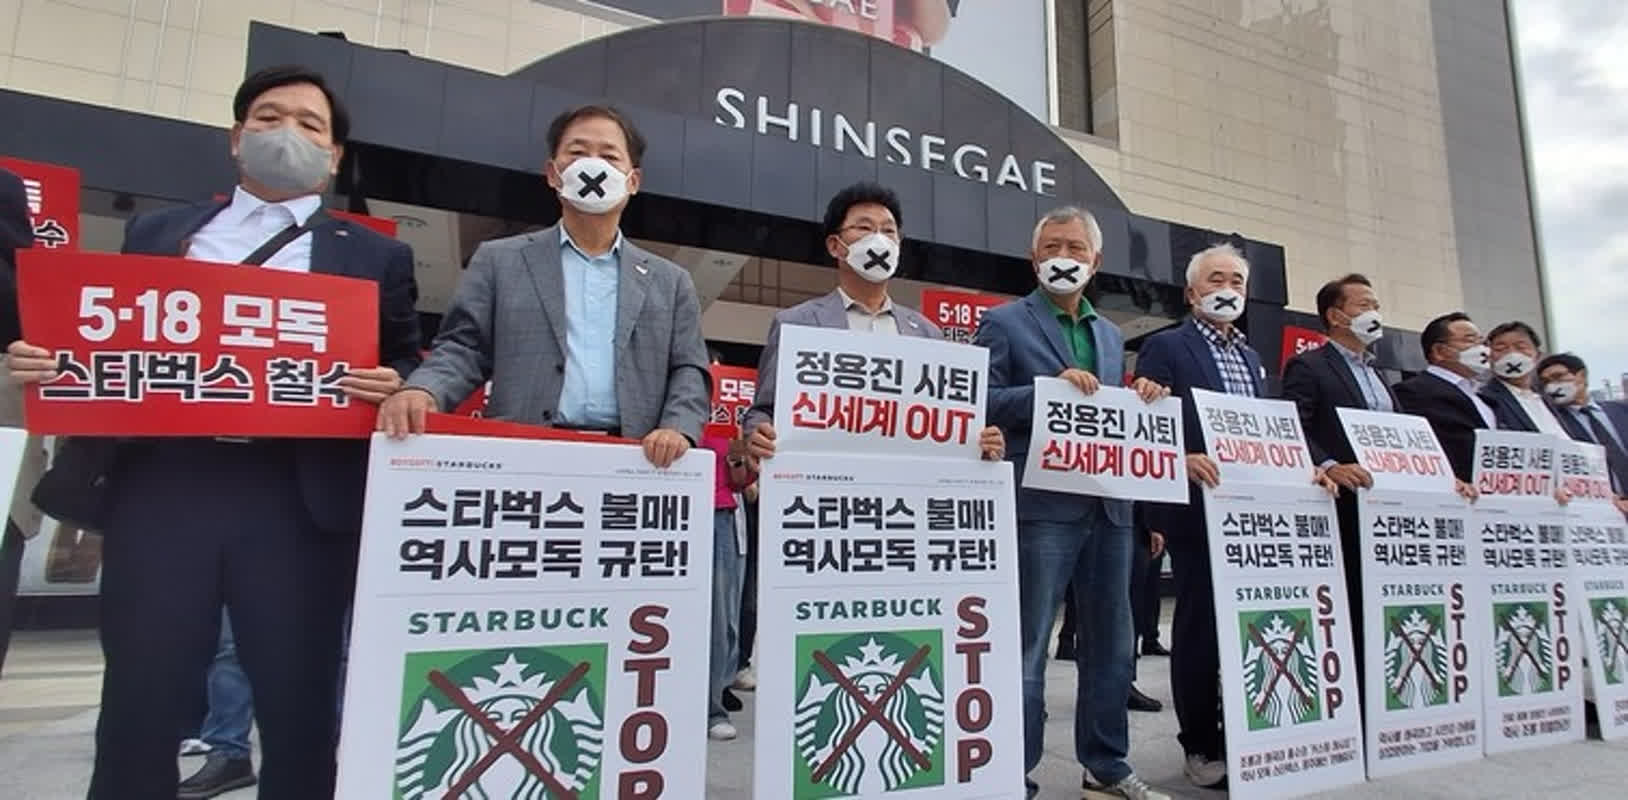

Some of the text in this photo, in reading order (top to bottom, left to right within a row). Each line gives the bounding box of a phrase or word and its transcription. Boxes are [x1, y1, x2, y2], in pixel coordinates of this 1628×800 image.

[715, 87, 1057, 197] SHINSEGAE
[219, 294, 328, 353] 모독
[40, 351, 254, 404] 스타벅스
[795, 351, 978, 405] 정용진 사퇴
[792, 391, 898, 438] 신세계
[905, 404, 975, 445] OUT
[1047, 401, 1177, 446] 정용진 사퇴
[1205, 407, 1299, 440] 정용진 사퇴
[1352, 424, 1404, 448] 정용진
[1041, 439, 1178, 480] 신세계 OUT
[1216, 437, 1305, 469] 신세계 OUT
[1412, 454, 1446, 476] OUT
[1481, 446, 1523, 469] 정용진
[401, 487, 689, 531] 스타벅스 불매!
[782, 496, 995, 530] 스타벅스 불매!
[1222, 512, 1291, 537] 스타벅스
[1373, 515, 1430, 538] 스타벅스
[1481, 523, 1534, 543] 스타벅스
[399, 538, 689, 580] 역사모독 규탄!
[782, 538, 997, 573] 역사모독 규탄!
[1225, 543, 1334, 568] 역사모독 규탄!
[1374, 543, 1432, 566] 역사모독
[1482, 548, 1536, 568] 역사모독
[1235, 585, 1310, 601] STARBUCK
[1381, 583, 1445, 597] STARBUCK
[408, 607, 609, 635] STARBUCK
[795, 598, 943, 619] STARBUCK
[1316, 584, 1343, 719] STOP
[1450, 583, 1468, 703] STOP
[1553, 582, 1571, 690] STOP
[955, 596, 993, 783] STOP
